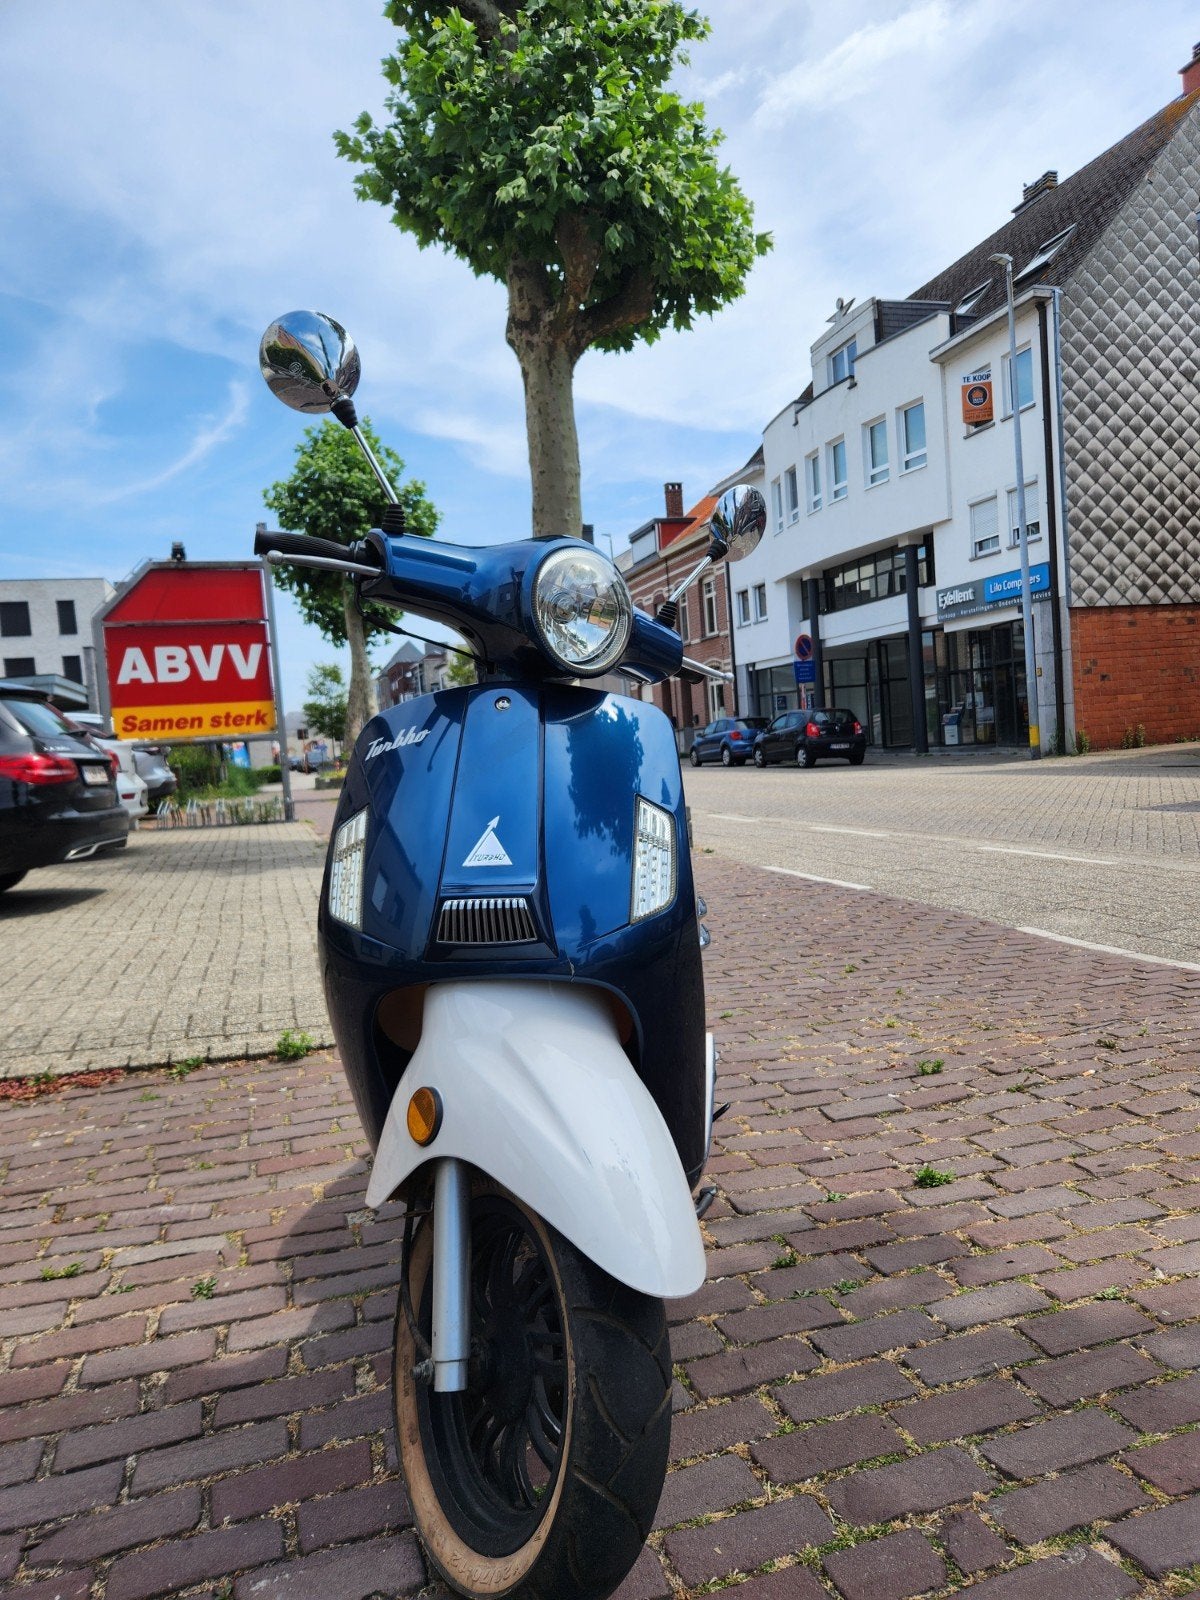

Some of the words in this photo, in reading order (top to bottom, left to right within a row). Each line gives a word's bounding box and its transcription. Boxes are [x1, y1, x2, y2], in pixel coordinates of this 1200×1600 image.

[972, 373, 992, 382] KOOP
[989, 582, 1002, 594] Lilo
[1002, 573, 1041, 591] Compers
[938, 587, 975, 609] Exellent
[117, 643, 263, 685] ABVV
[121, 713, 203, 733] Samen
[210, 709, 269, 729] sterk
